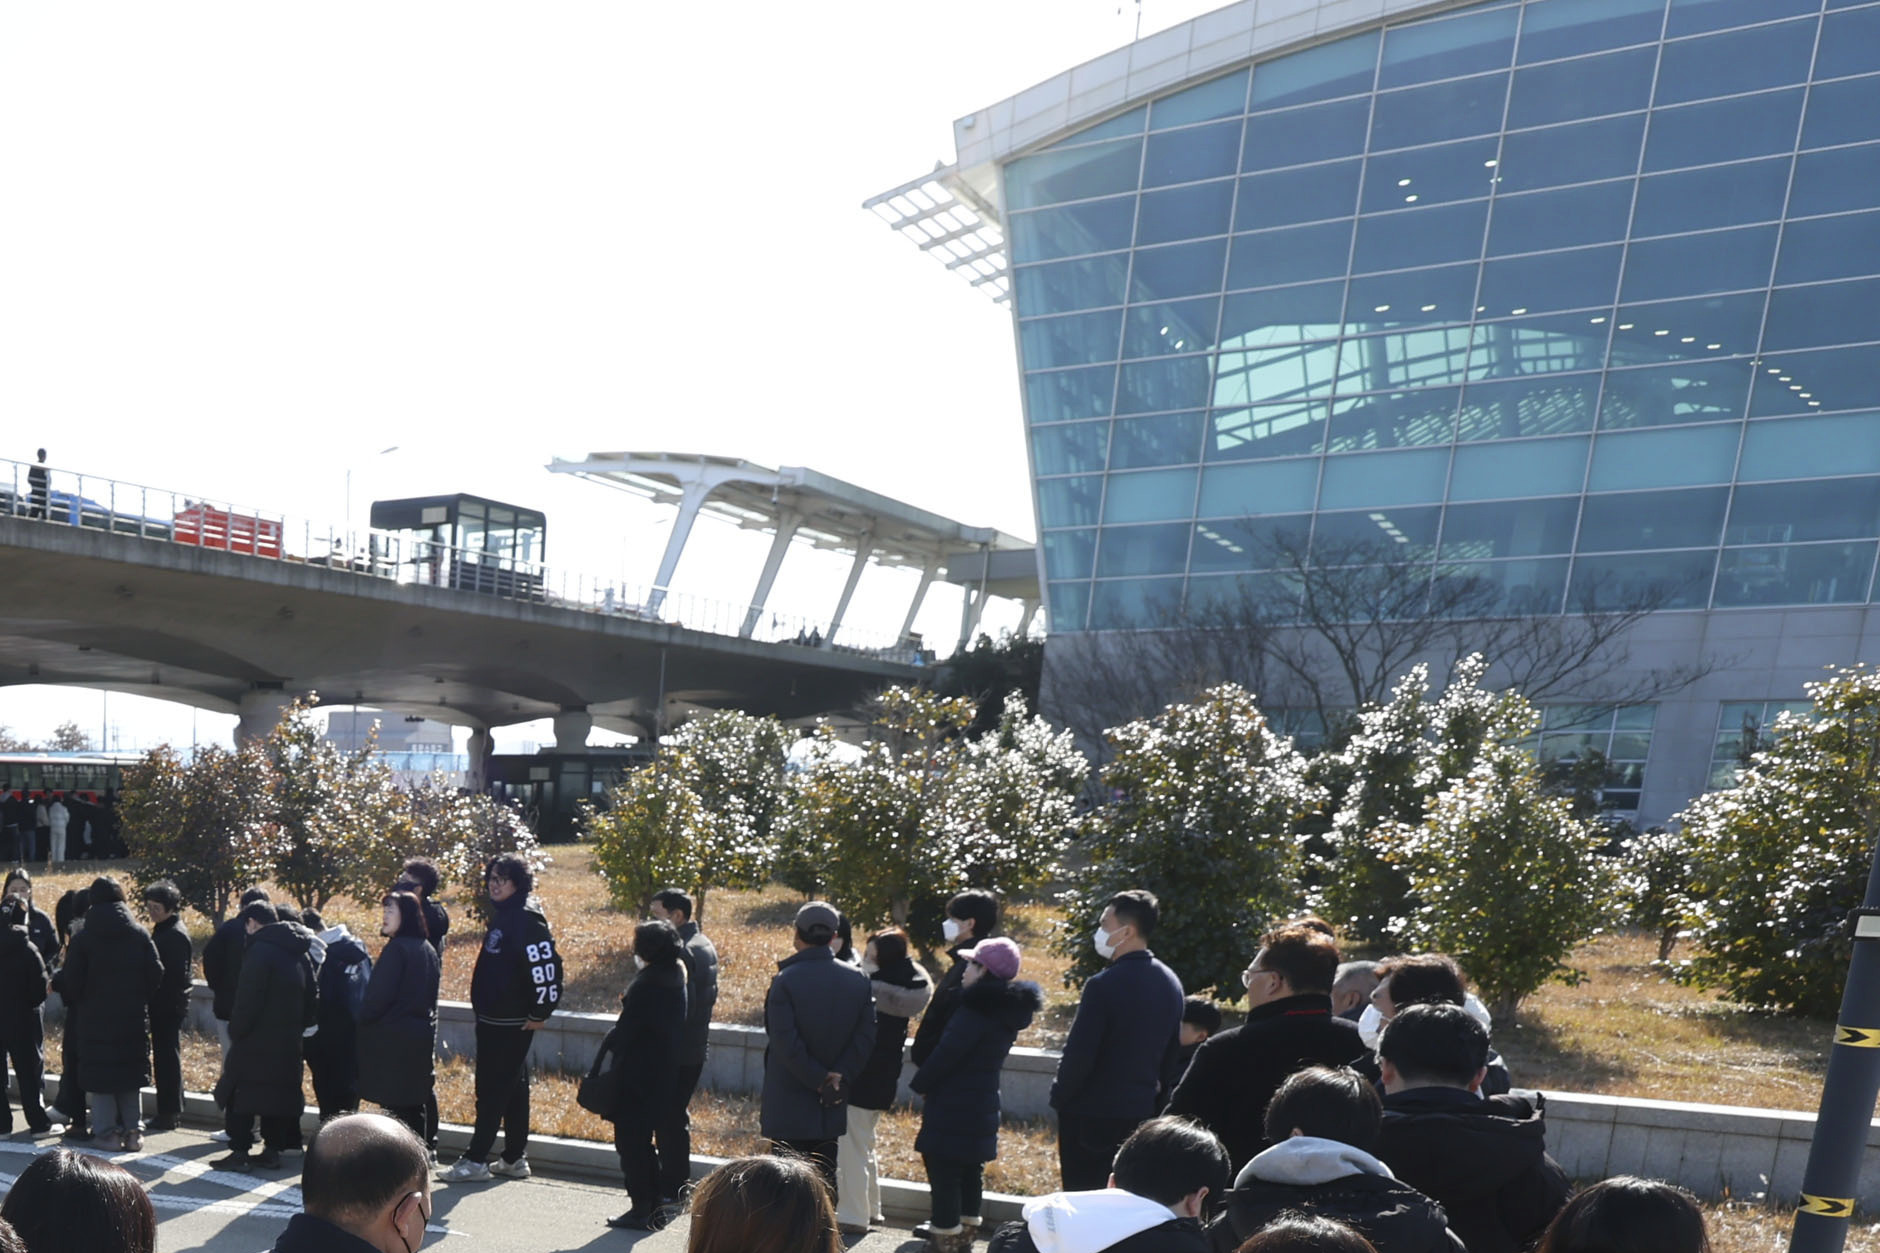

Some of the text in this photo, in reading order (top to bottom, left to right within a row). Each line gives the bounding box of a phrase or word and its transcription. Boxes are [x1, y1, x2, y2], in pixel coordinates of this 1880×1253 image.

[526, 941, 552, 962] 83
[531, 963, 555, 984] 80
[536, 985, 558, 1004] 76
